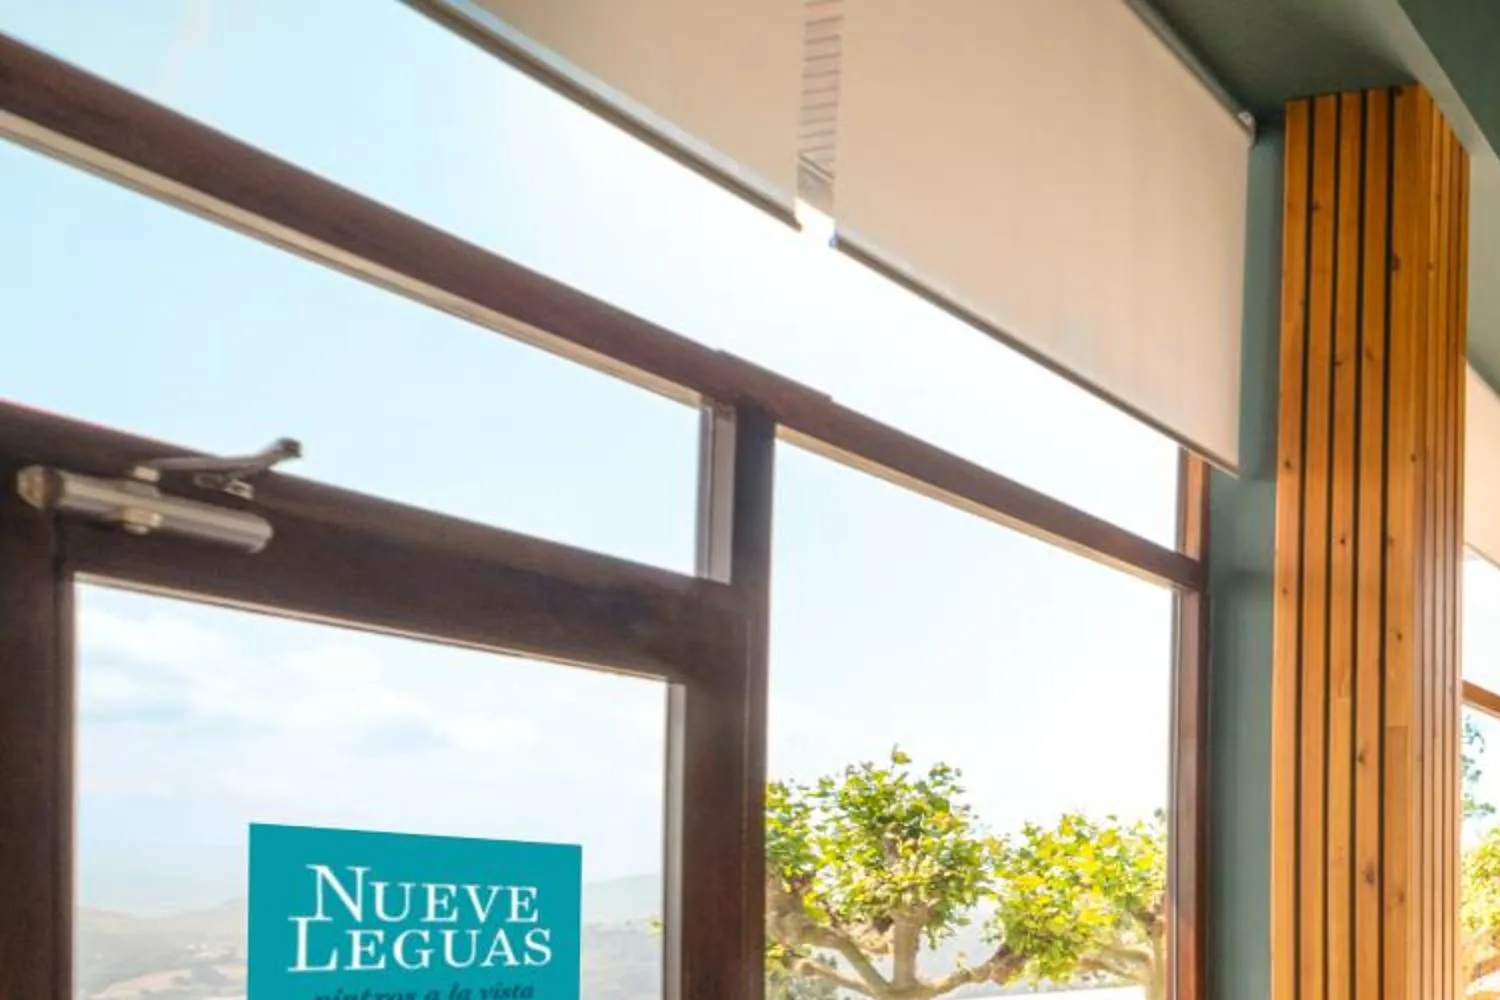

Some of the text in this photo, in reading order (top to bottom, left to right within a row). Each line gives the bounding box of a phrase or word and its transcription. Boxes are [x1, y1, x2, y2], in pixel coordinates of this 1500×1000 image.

[305, 864, 539, 922] NUEVE
[287, 916, 552, 972] LEGUAS
[480, 981, 534, 1000] vista
